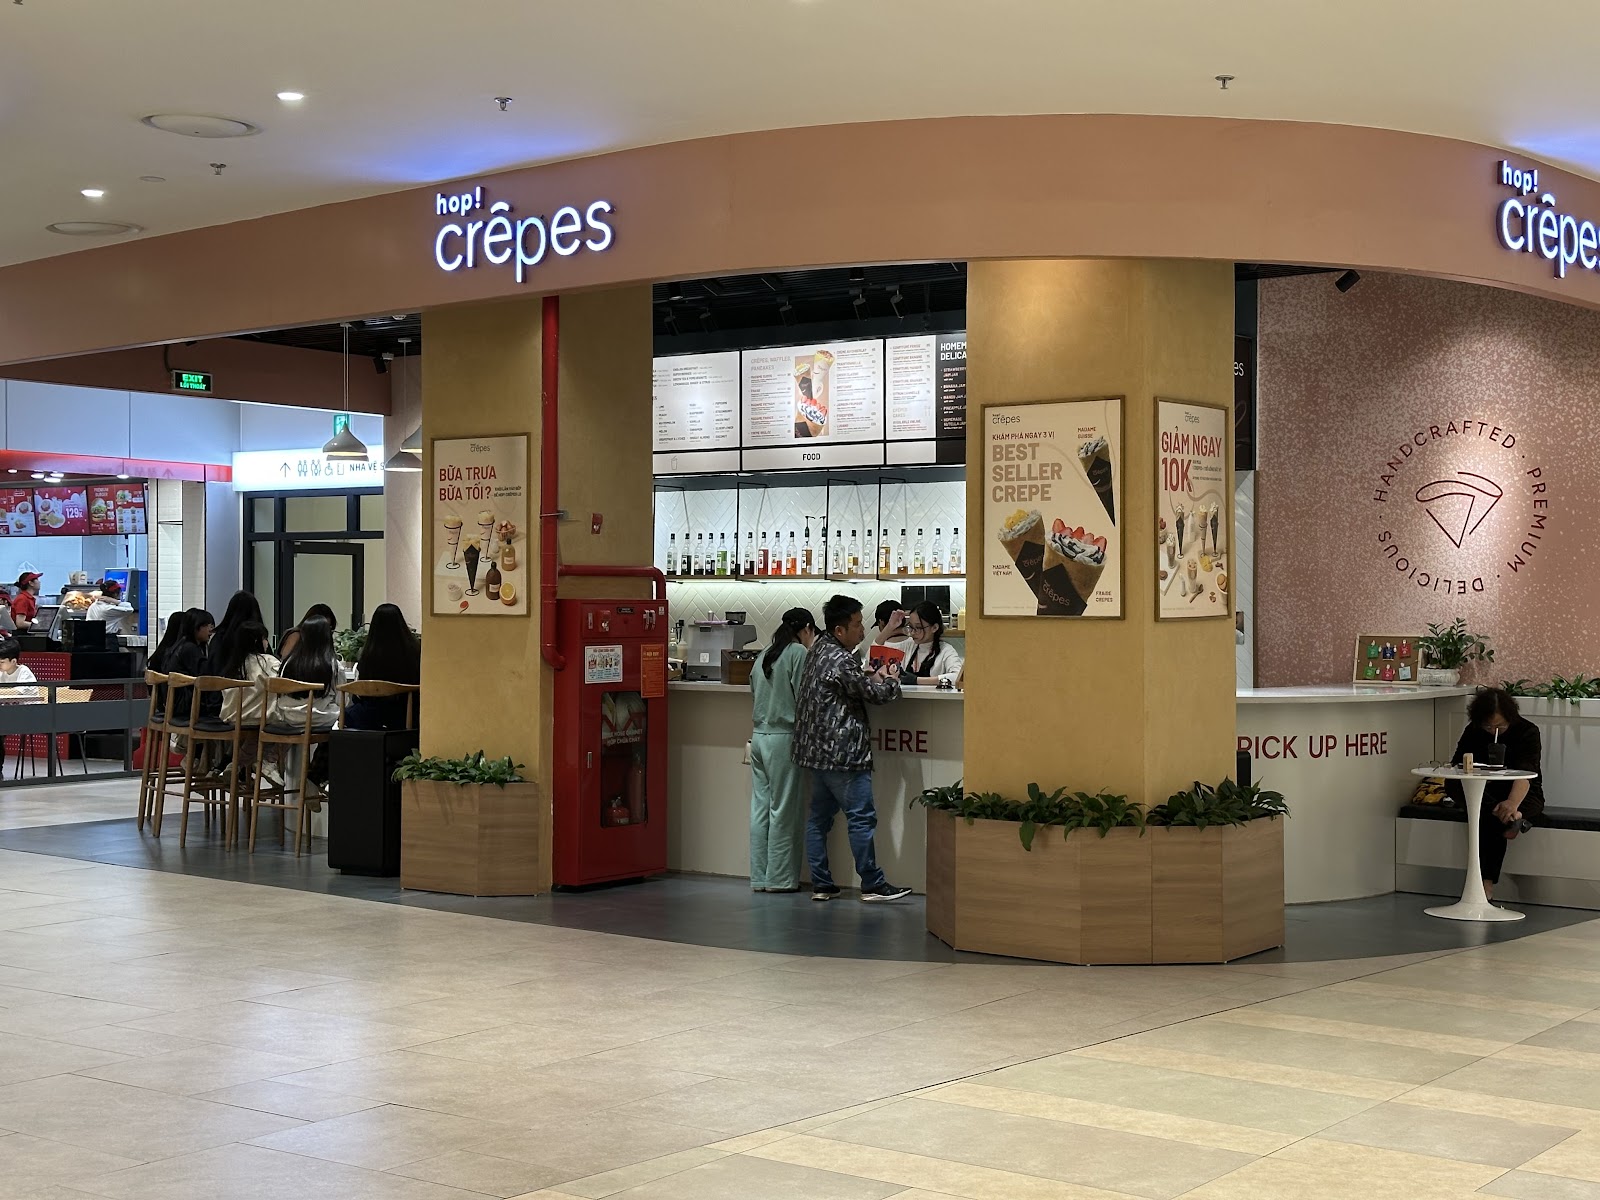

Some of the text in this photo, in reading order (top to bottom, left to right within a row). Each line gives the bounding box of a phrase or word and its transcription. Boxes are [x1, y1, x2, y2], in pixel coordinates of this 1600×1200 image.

[1500, 160, 1538, 196] hop!
[435, 186, 482, 217] hop!
[434, 200, 615, 284] crêpes
[1499, 193, 1600, 278] crêpe
[182, 373, 204, 383] EXIT
[993, 415, 1021, 426] crêpes
[1025, 431, 1042, 439] NGAY
[1161, 425, 1222, 458] GIẢM NGAY
[802, 453, 821, 461] FOOD
[992, 442, 1040, 462] BEST
[439, 464, 497, 482] BỮA TRƯA
[992, 462, 1063, 482] SELLER
[1161, 457, 1192, 492] 10K
[439, 484, 463, 502] BỮA
[992, 483, 1052, 503] CREPE
[1373, 420, 1548, 595] HANDCRAFTED PREMIUM DELICIOUS
[1043, 583, 1070, 606] crêpes
[870, 728, 928, 753] HERE
[1237, 732, 1388, 759] PICK UP HERE
